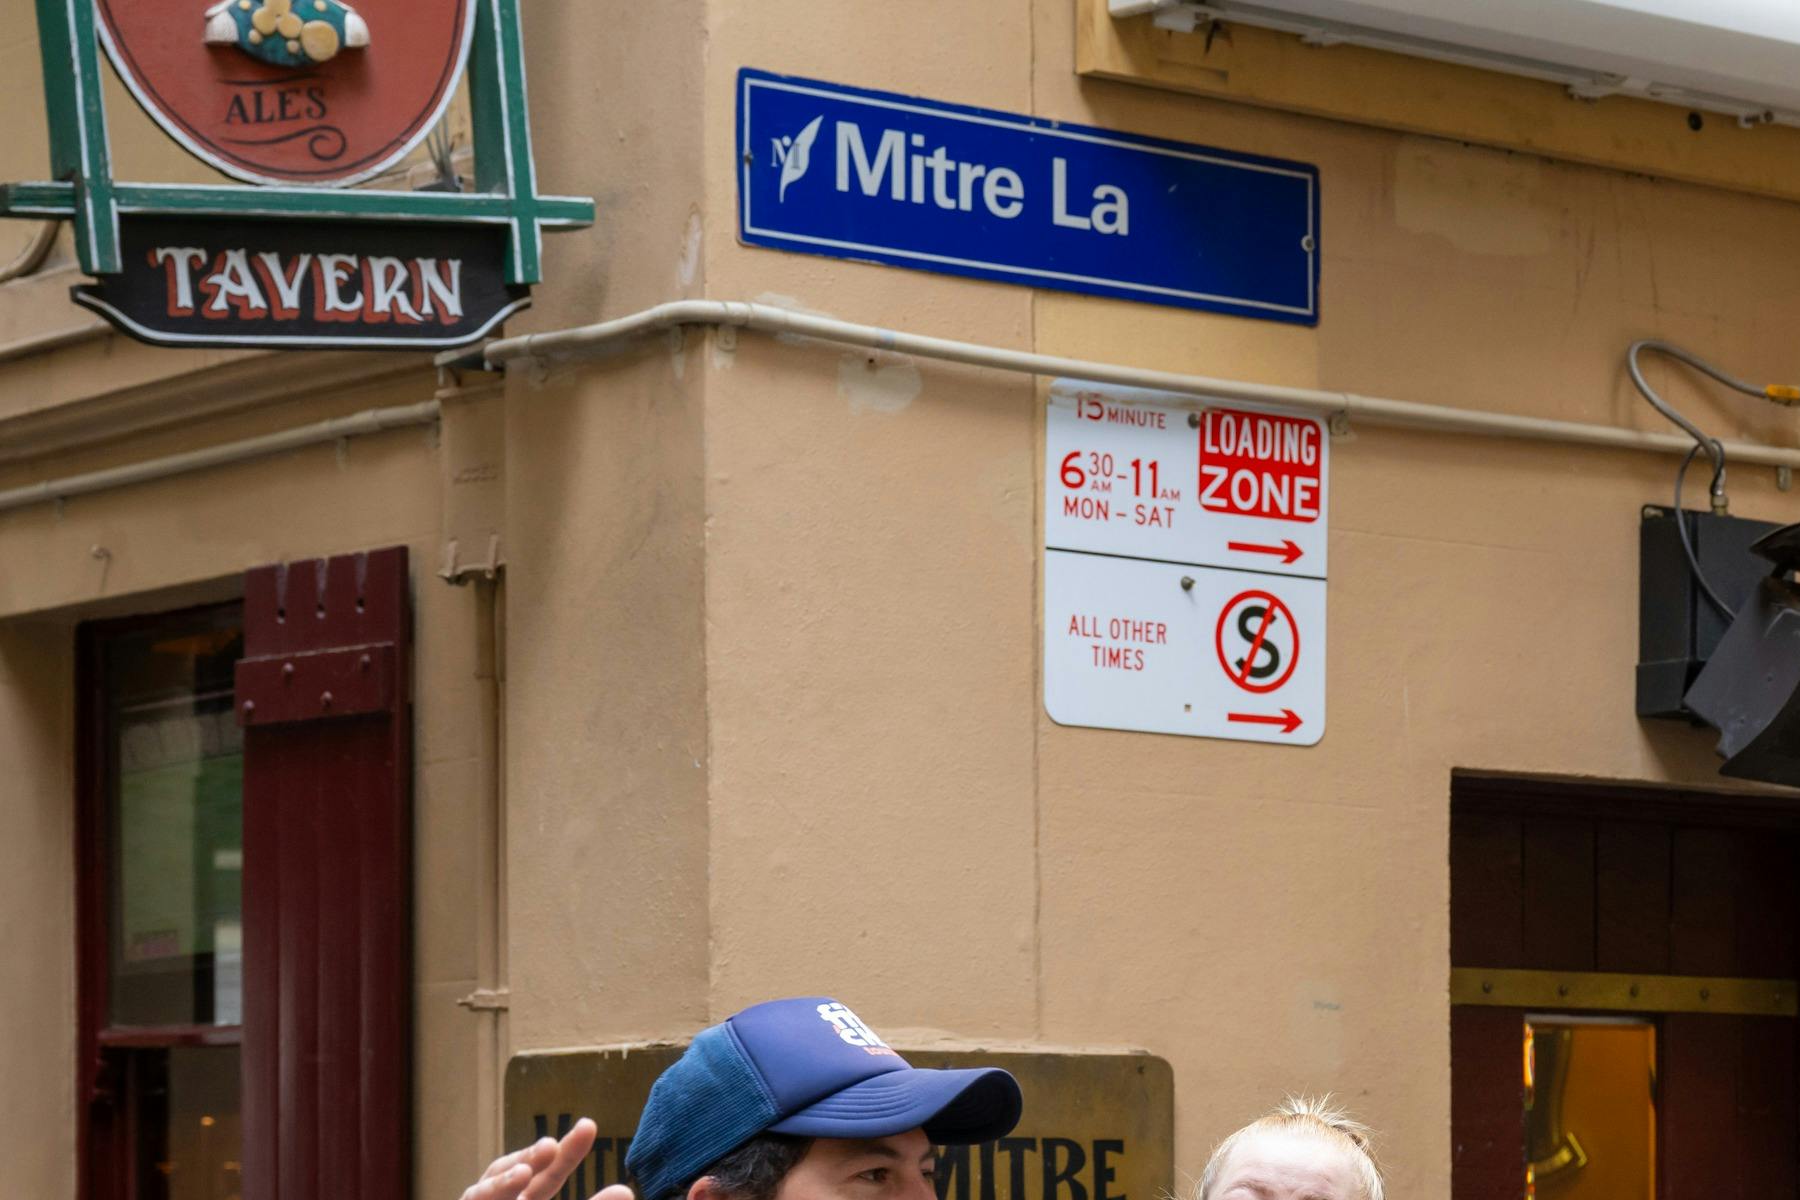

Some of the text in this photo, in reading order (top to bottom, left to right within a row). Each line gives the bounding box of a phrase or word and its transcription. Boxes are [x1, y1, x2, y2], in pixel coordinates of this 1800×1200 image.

[224, 87, 328, 124] ALES
[836, 121, 1129, 236] Mitre La
[149, 247, 464, 323] TAVERN
[1076, 391, 1166, 429] 15 MINUTE
[1204, 412, 1316, 467] LOADING
[1200, 465, 1319, 518] ZONE
[1064, 496, 1110, 522] MON
[1135, 504, 1175, 529] SAT
[1069, 613, 1167, 645] ALL OTHER
[1092, 645, 1145, 672] TIMES
